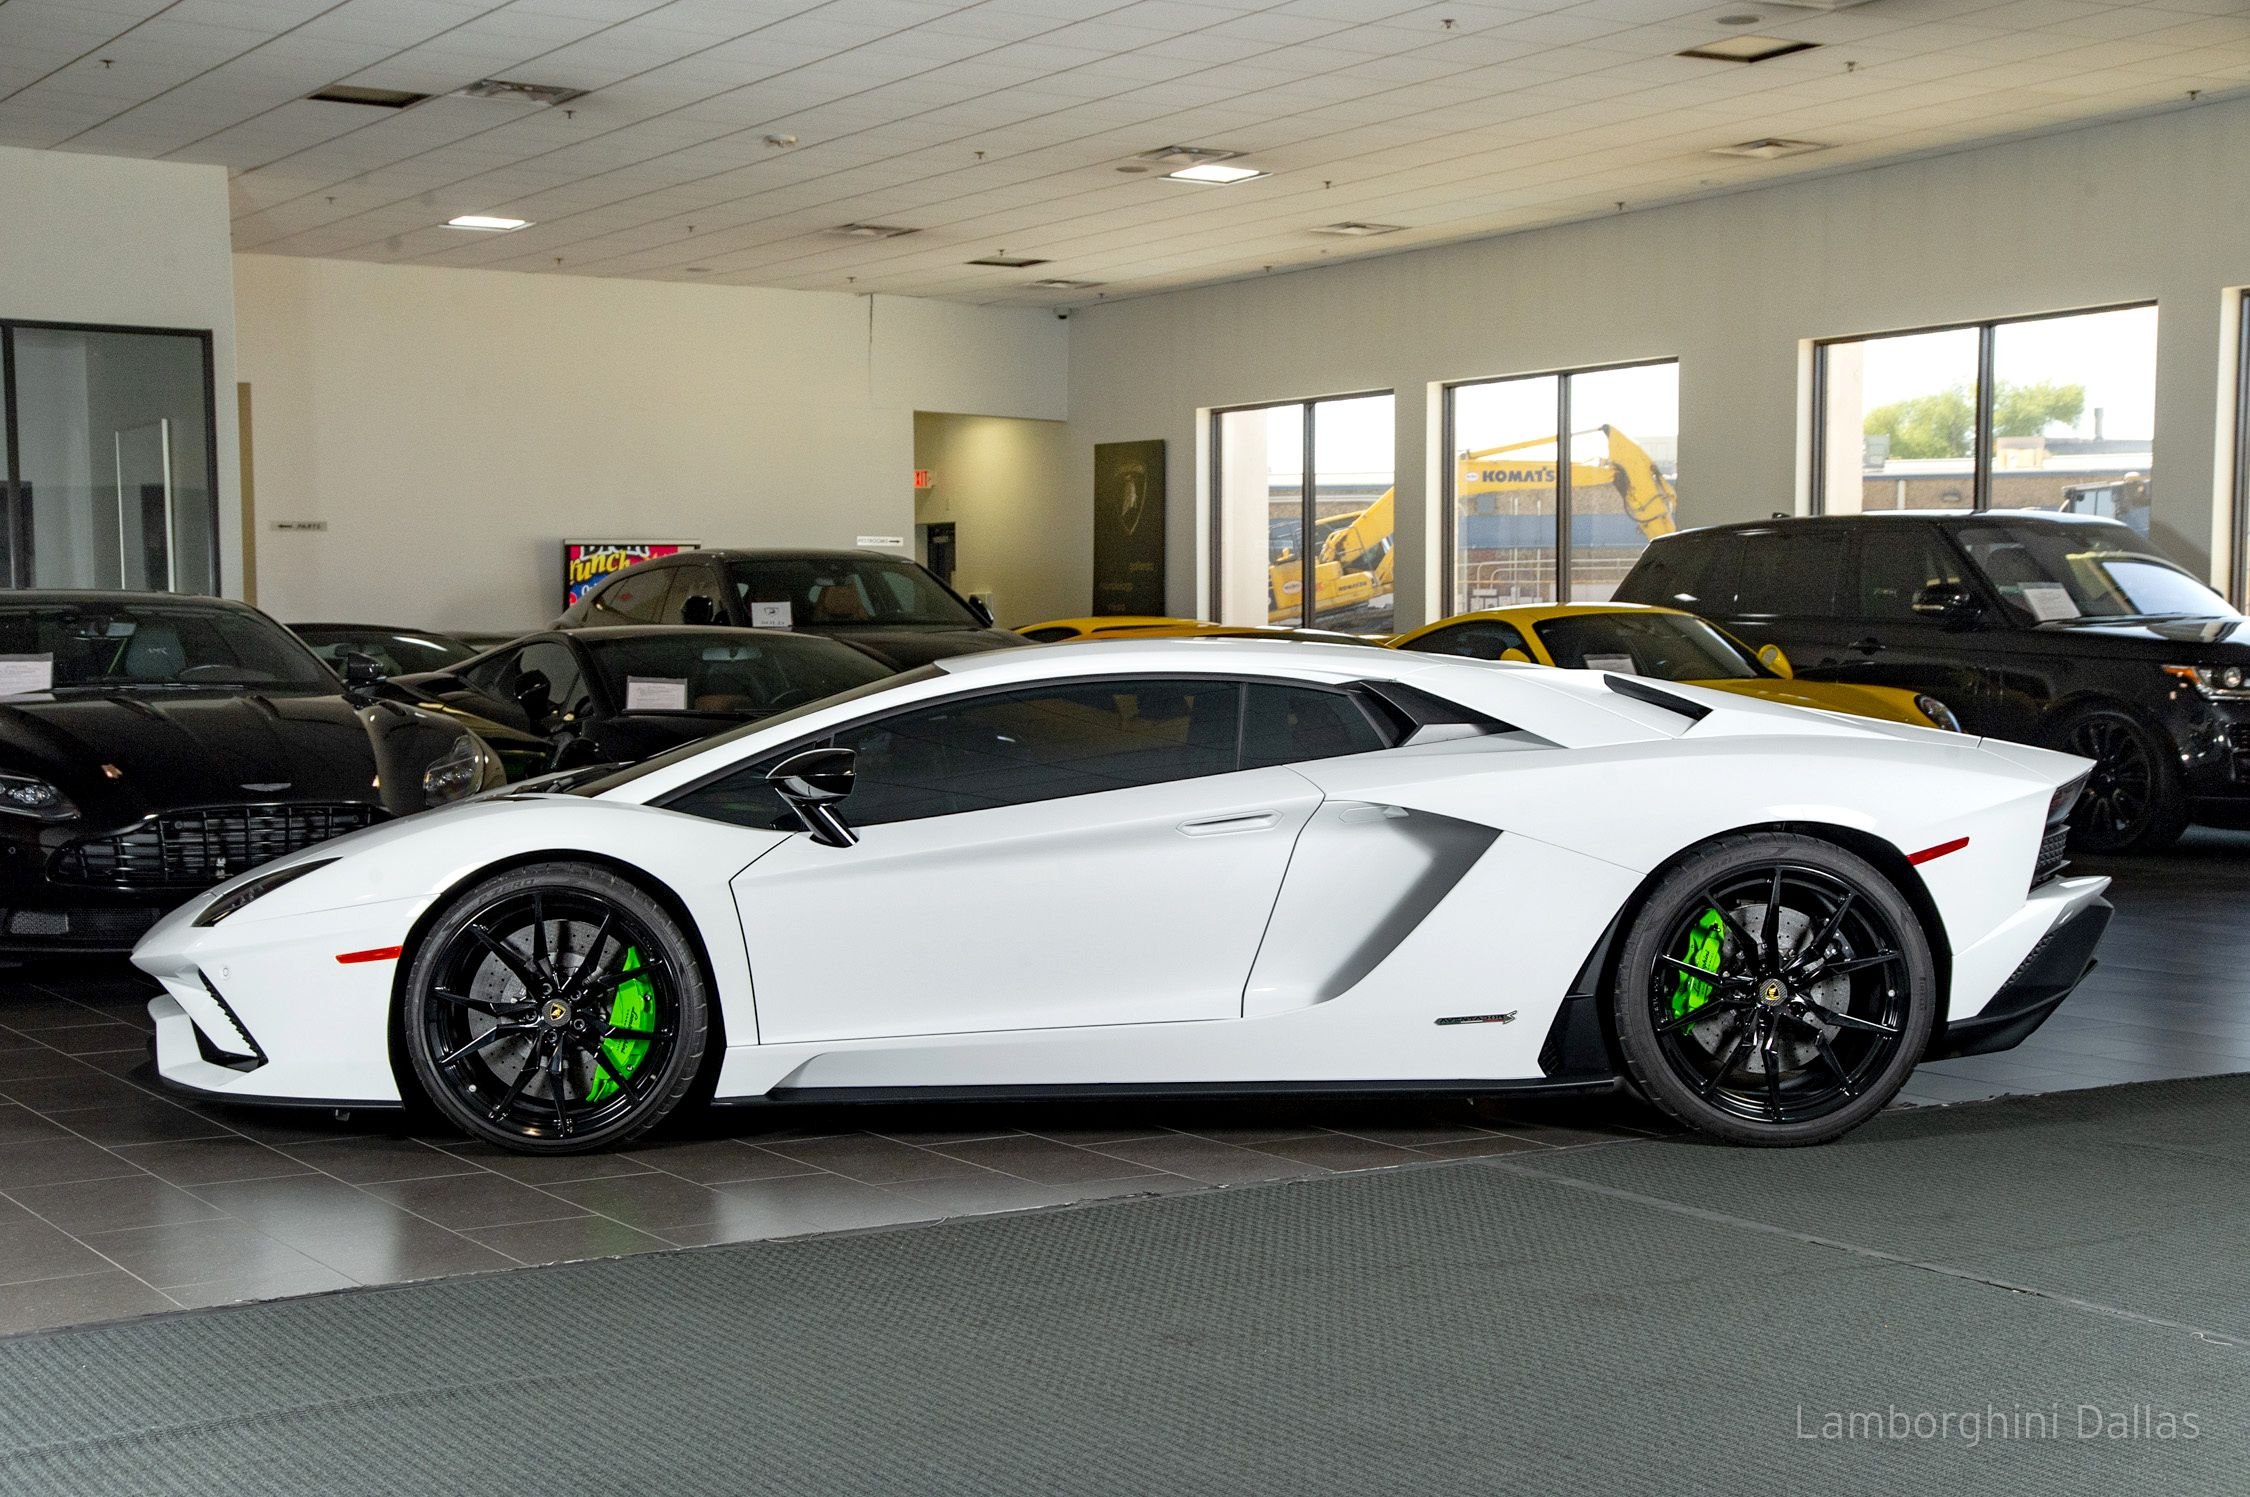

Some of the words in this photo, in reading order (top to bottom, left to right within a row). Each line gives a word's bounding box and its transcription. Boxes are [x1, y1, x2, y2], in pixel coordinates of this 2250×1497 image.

[914, 470, 928, 488] XIT
[1482, 469, 1556, 482] KOMATS
[569, 550, 631, 582] runch
